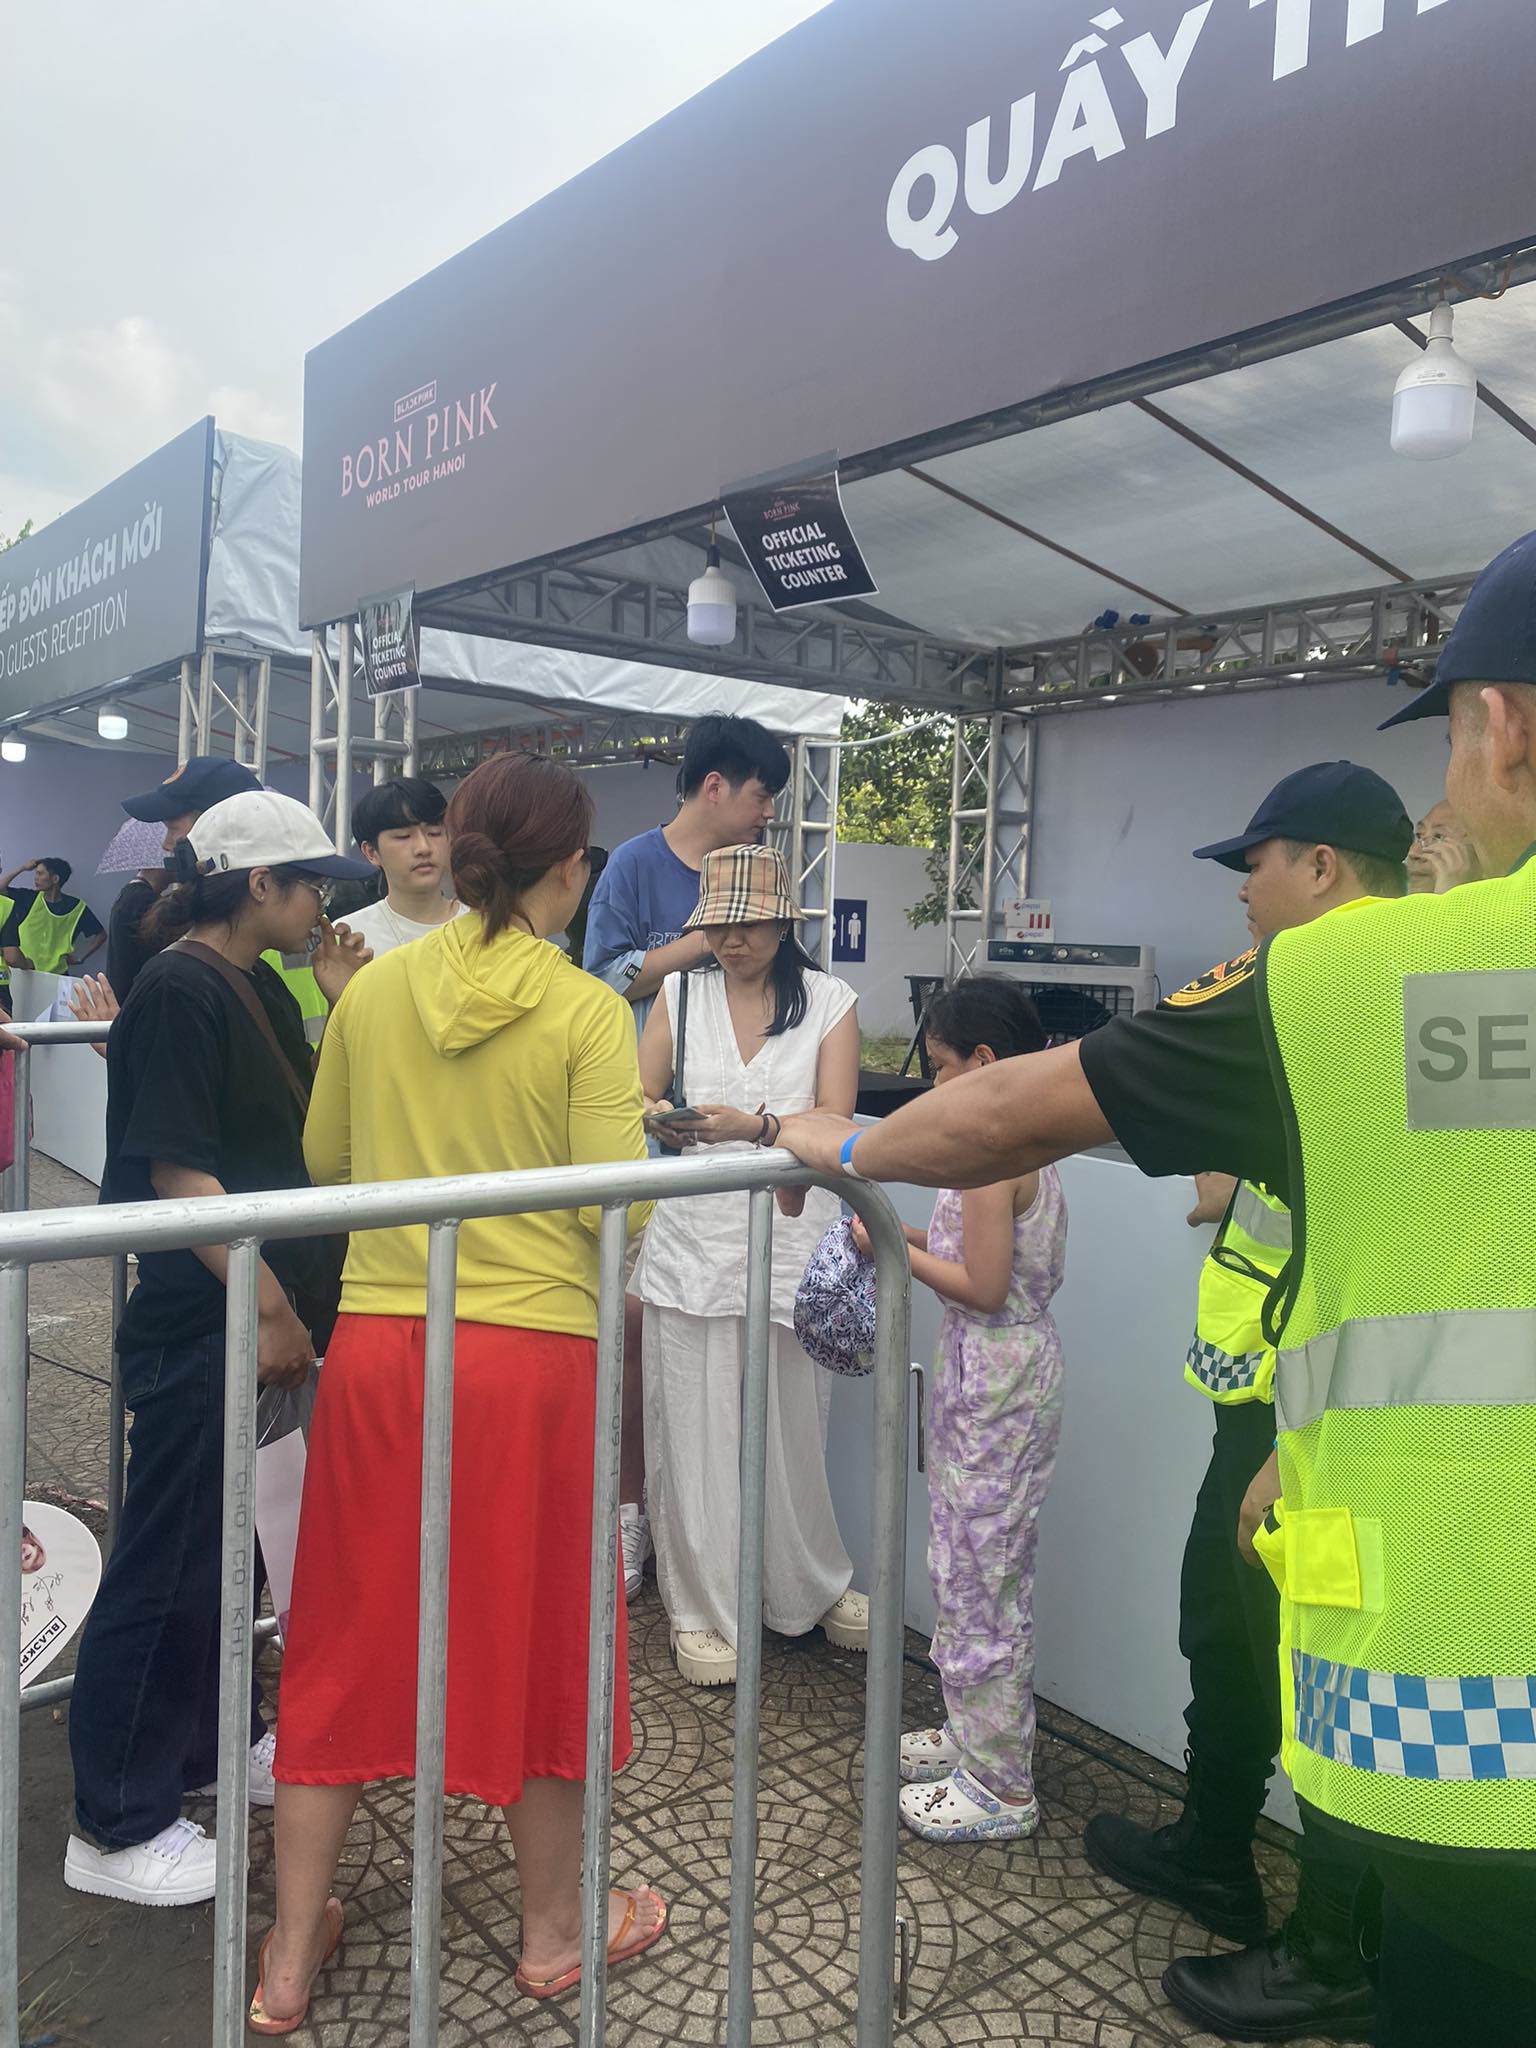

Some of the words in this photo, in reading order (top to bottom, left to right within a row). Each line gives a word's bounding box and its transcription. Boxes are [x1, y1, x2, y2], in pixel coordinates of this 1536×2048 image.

[886, 0, 1214, 261] QUẦY
[341, 423, 414, 497] BORN
[425, 381, 499, 461] PINK
[366, 484, 401, 509] WORLD
[403, 469, 430, 493] TOUR
[432, 452, 466, 481] HANOI
[761, 521, 827, 551] OFFICIAL
[18, 567, 52, 624] ĐÓN
[55, 537, 118, 605] KHÁCH
[121, 501, 163, 571] MỜI
[765, 541, 842, 572] TICKETING
[780, 564, 848, 590] COUNTER
[7, 628, 48, 677] GUESTS
[51, 588, 128, 659] RECEPTION
[372, 630, 403, 649] OFFICIAL
[371, 645, 407, 666] TICKETING
[374, 661, 408, 681] COUNTER
[20, 1622, 60, 1667] BLACKP
